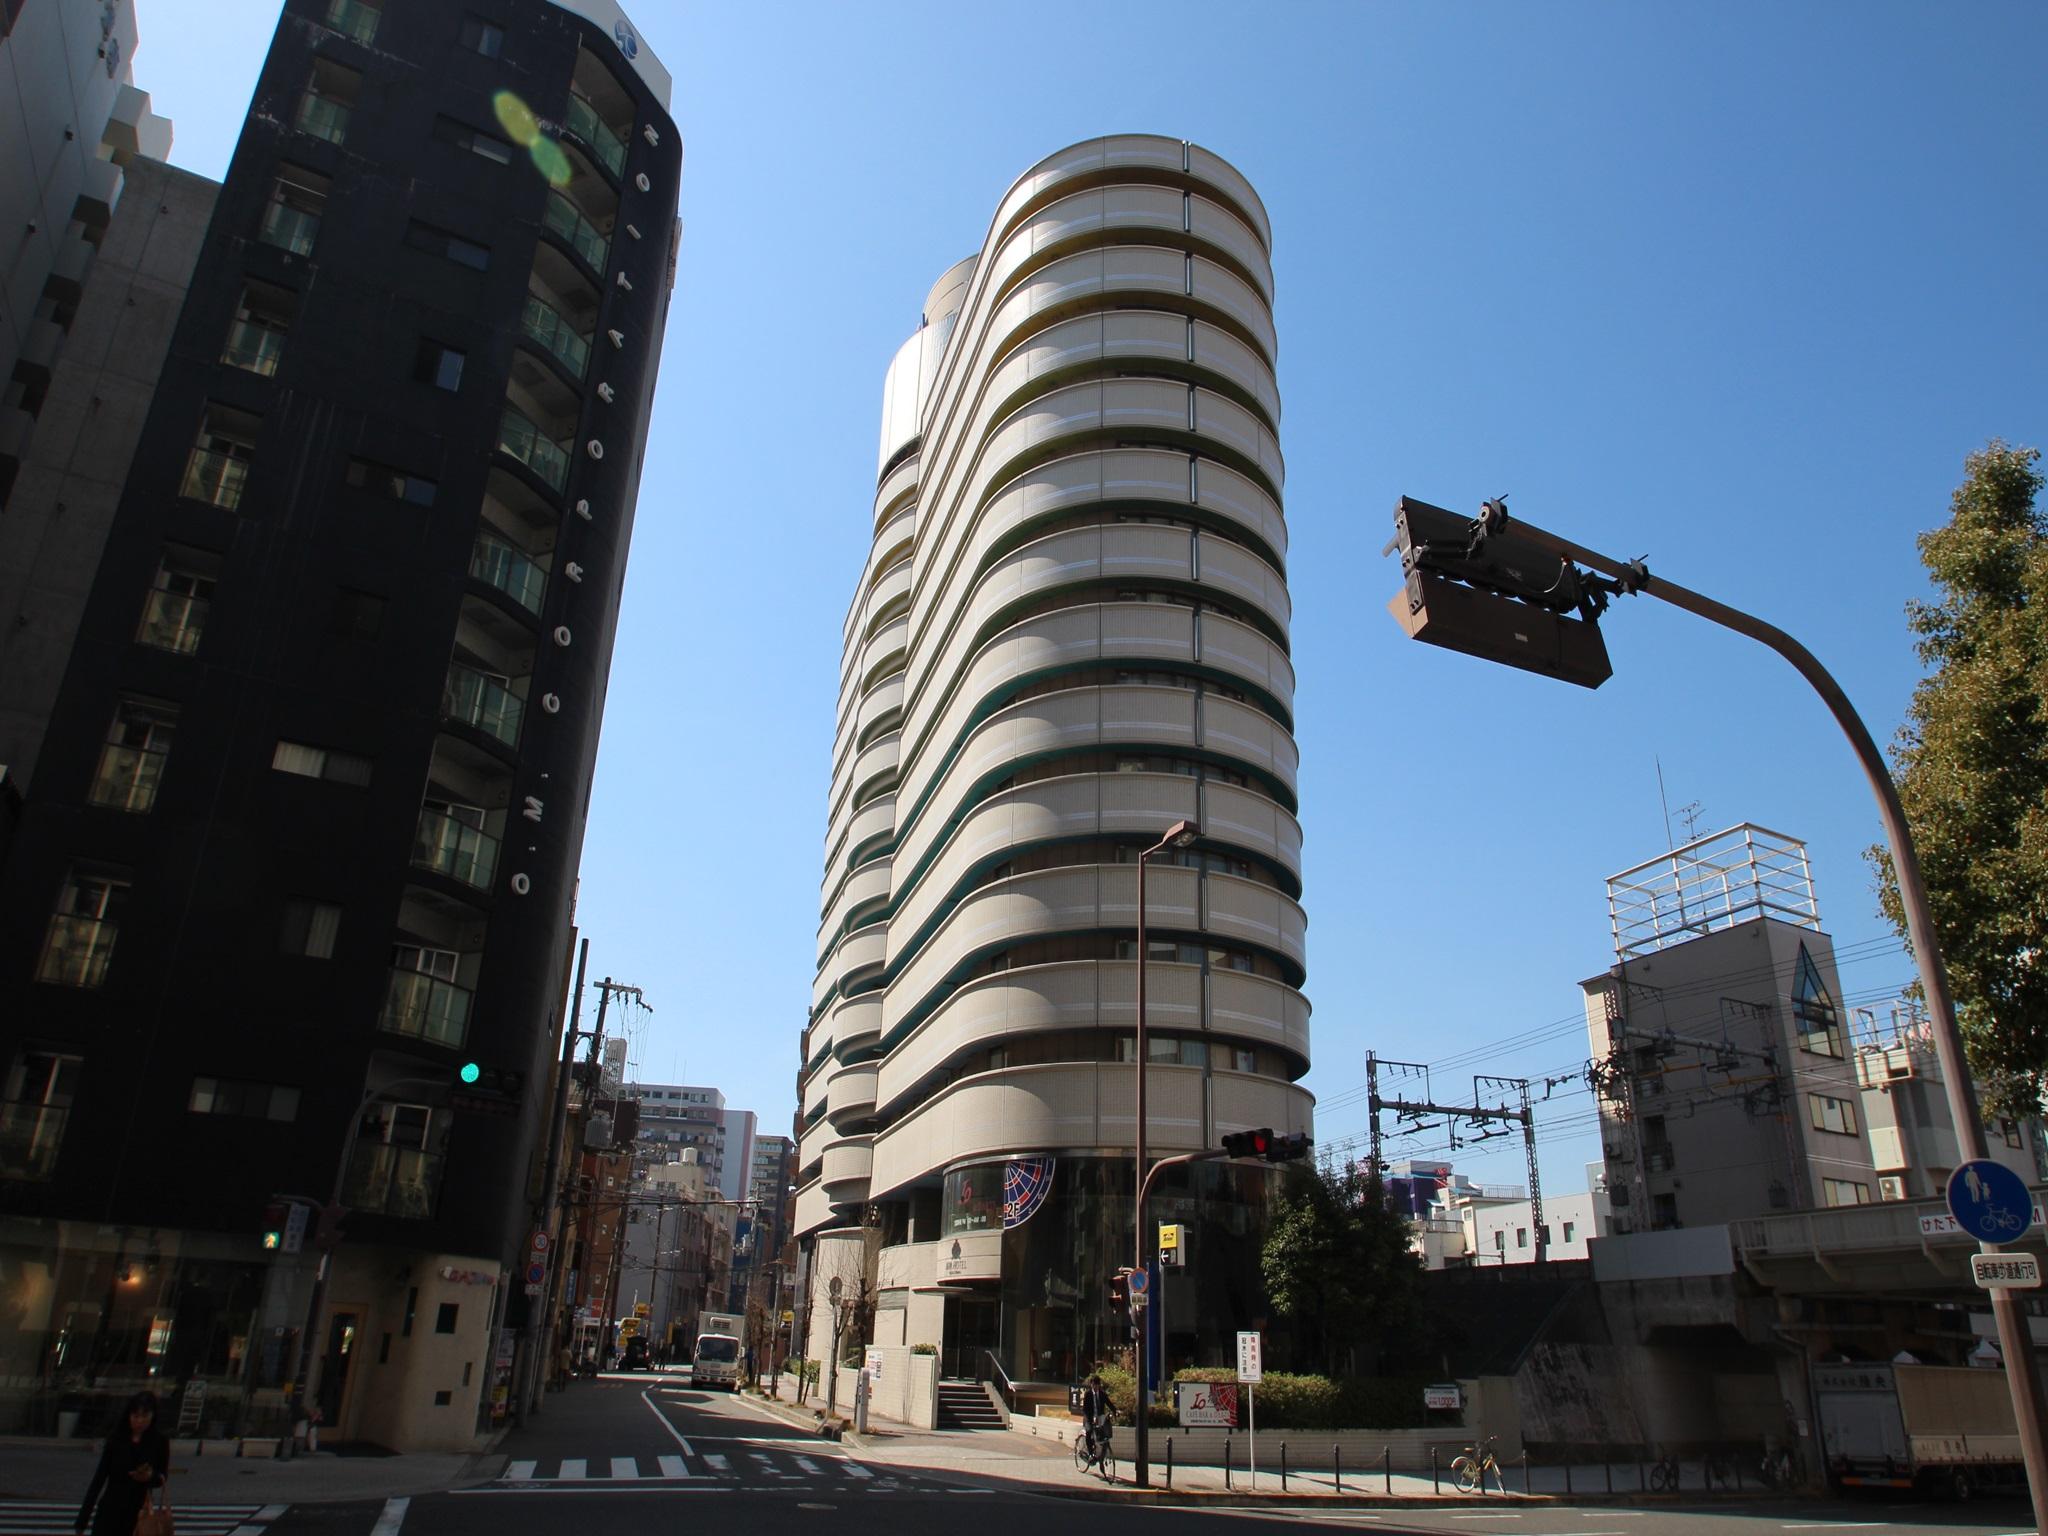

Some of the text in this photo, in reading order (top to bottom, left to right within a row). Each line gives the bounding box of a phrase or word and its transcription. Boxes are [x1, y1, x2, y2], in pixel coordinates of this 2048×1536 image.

[1007, 1201, 1020, 1218] 2F
[1921, 1215, 1956, 1232] けた下
[1975, 1261, 2037, 1280] 自転車歩道通行可
